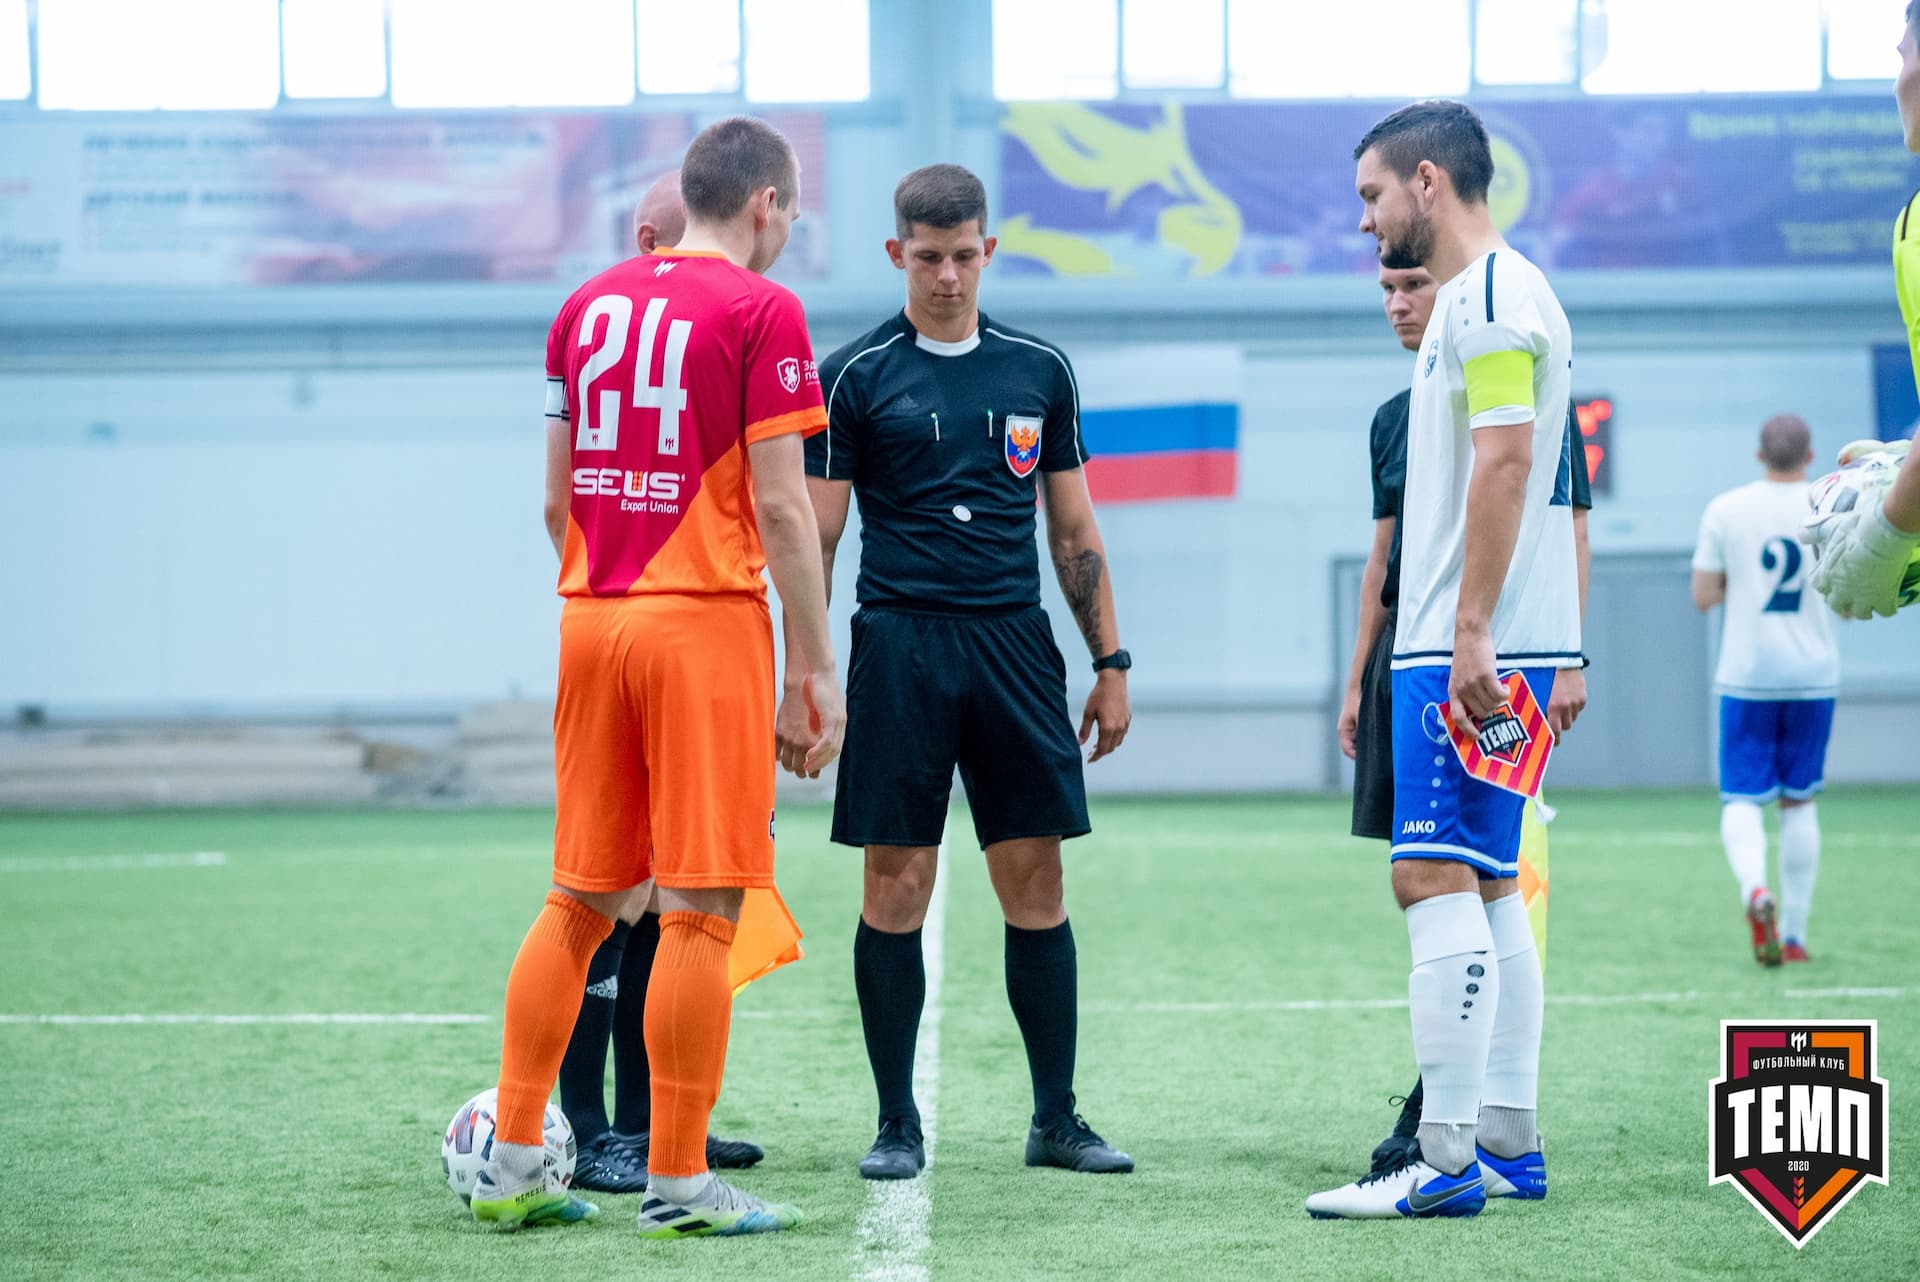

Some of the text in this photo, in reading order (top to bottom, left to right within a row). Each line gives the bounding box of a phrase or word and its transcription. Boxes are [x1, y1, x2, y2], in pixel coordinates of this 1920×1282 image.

[575, 293, 693, 456] 24
[620, 498, 679, 514] Export Union
[1759, 535, 1803, 613] 2
[1480, 719, 1524, 753] ТЕМП
[1402, 820, 1436, 834] JAKO
